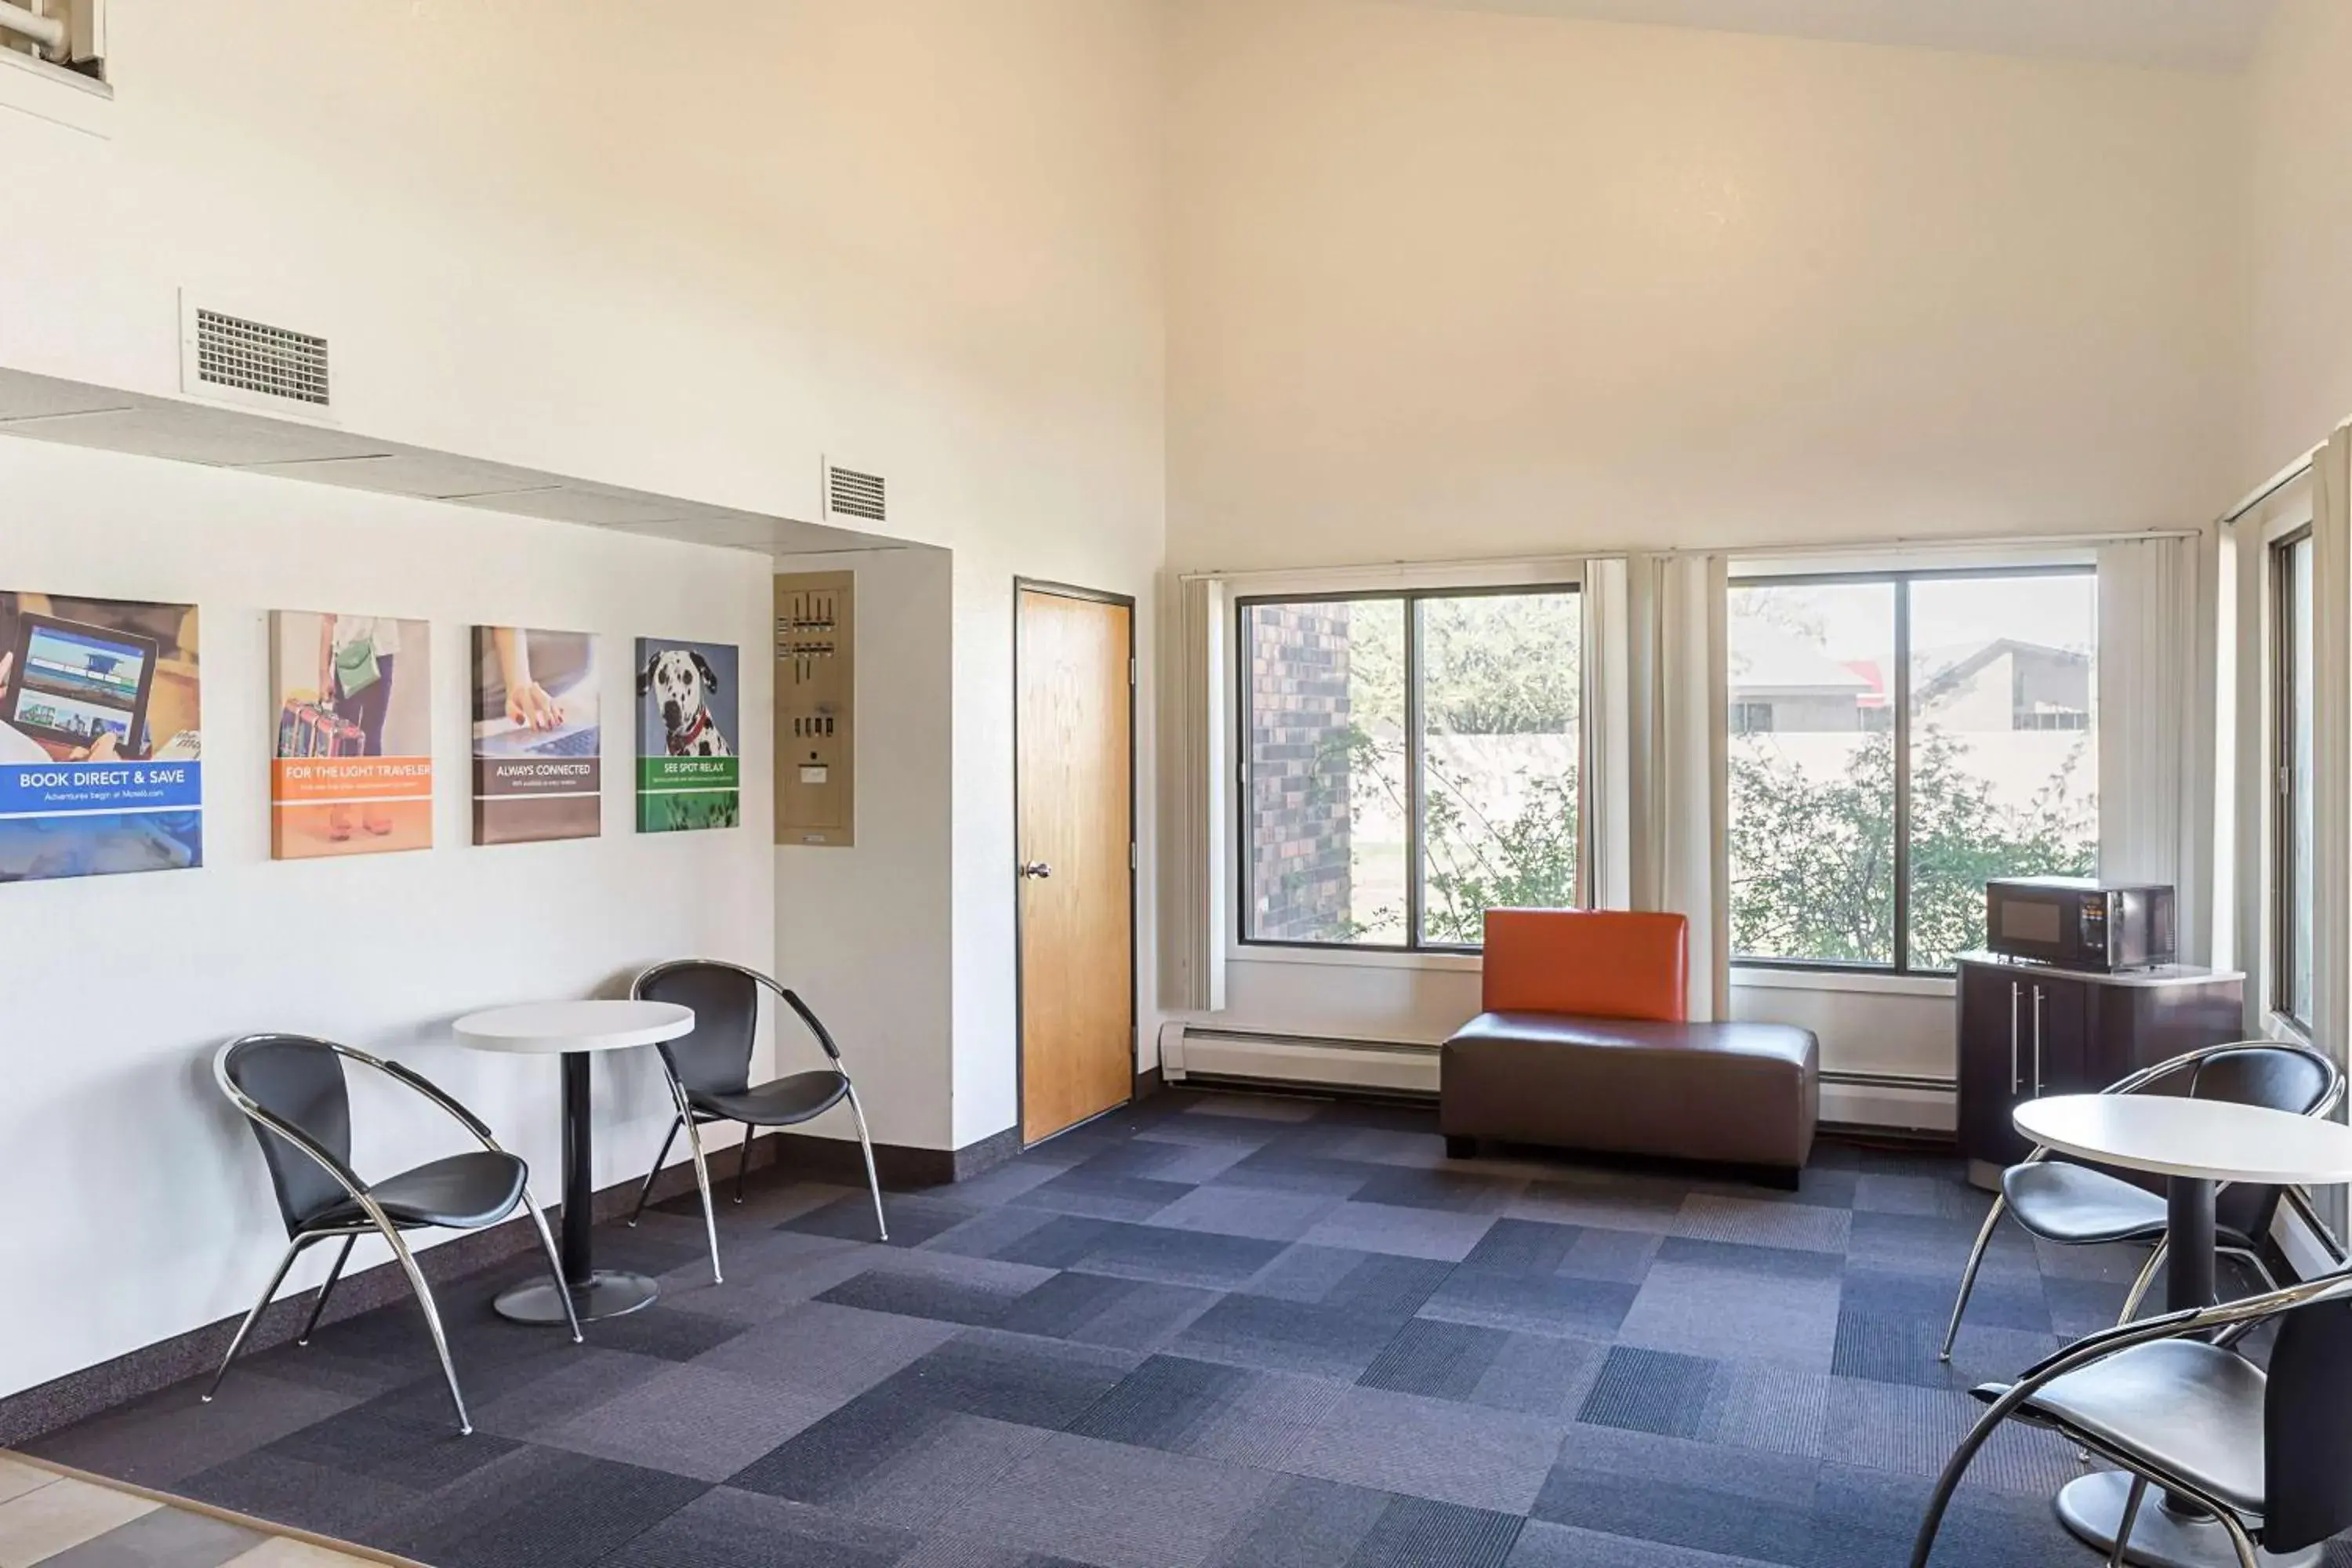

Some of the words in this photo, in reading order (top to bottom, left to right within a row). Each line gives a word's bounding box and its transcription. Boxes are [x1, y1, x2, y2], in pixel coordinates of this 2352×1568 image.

[285, 766, 311, 779] FOR
[316, 765, 338, 778] THE
[339, 765, 374, 777] LIGHT
[377, 764, 431, 776] TRAVELER
[496, 765, 534, 776] ALWAYS
[536, 764, 590, 775] CONNECTED
[664, 763, 678, 773] SEE
[680, 763, 699, 772] SPOT
[699, 763, 724, 772] RELAX
[20, 772, 69, 788] BOOK
[74, 771, 129, 786] DIRECT
[134, 771, 145, 783] &
[150, 770, 185, 783] SAVE
